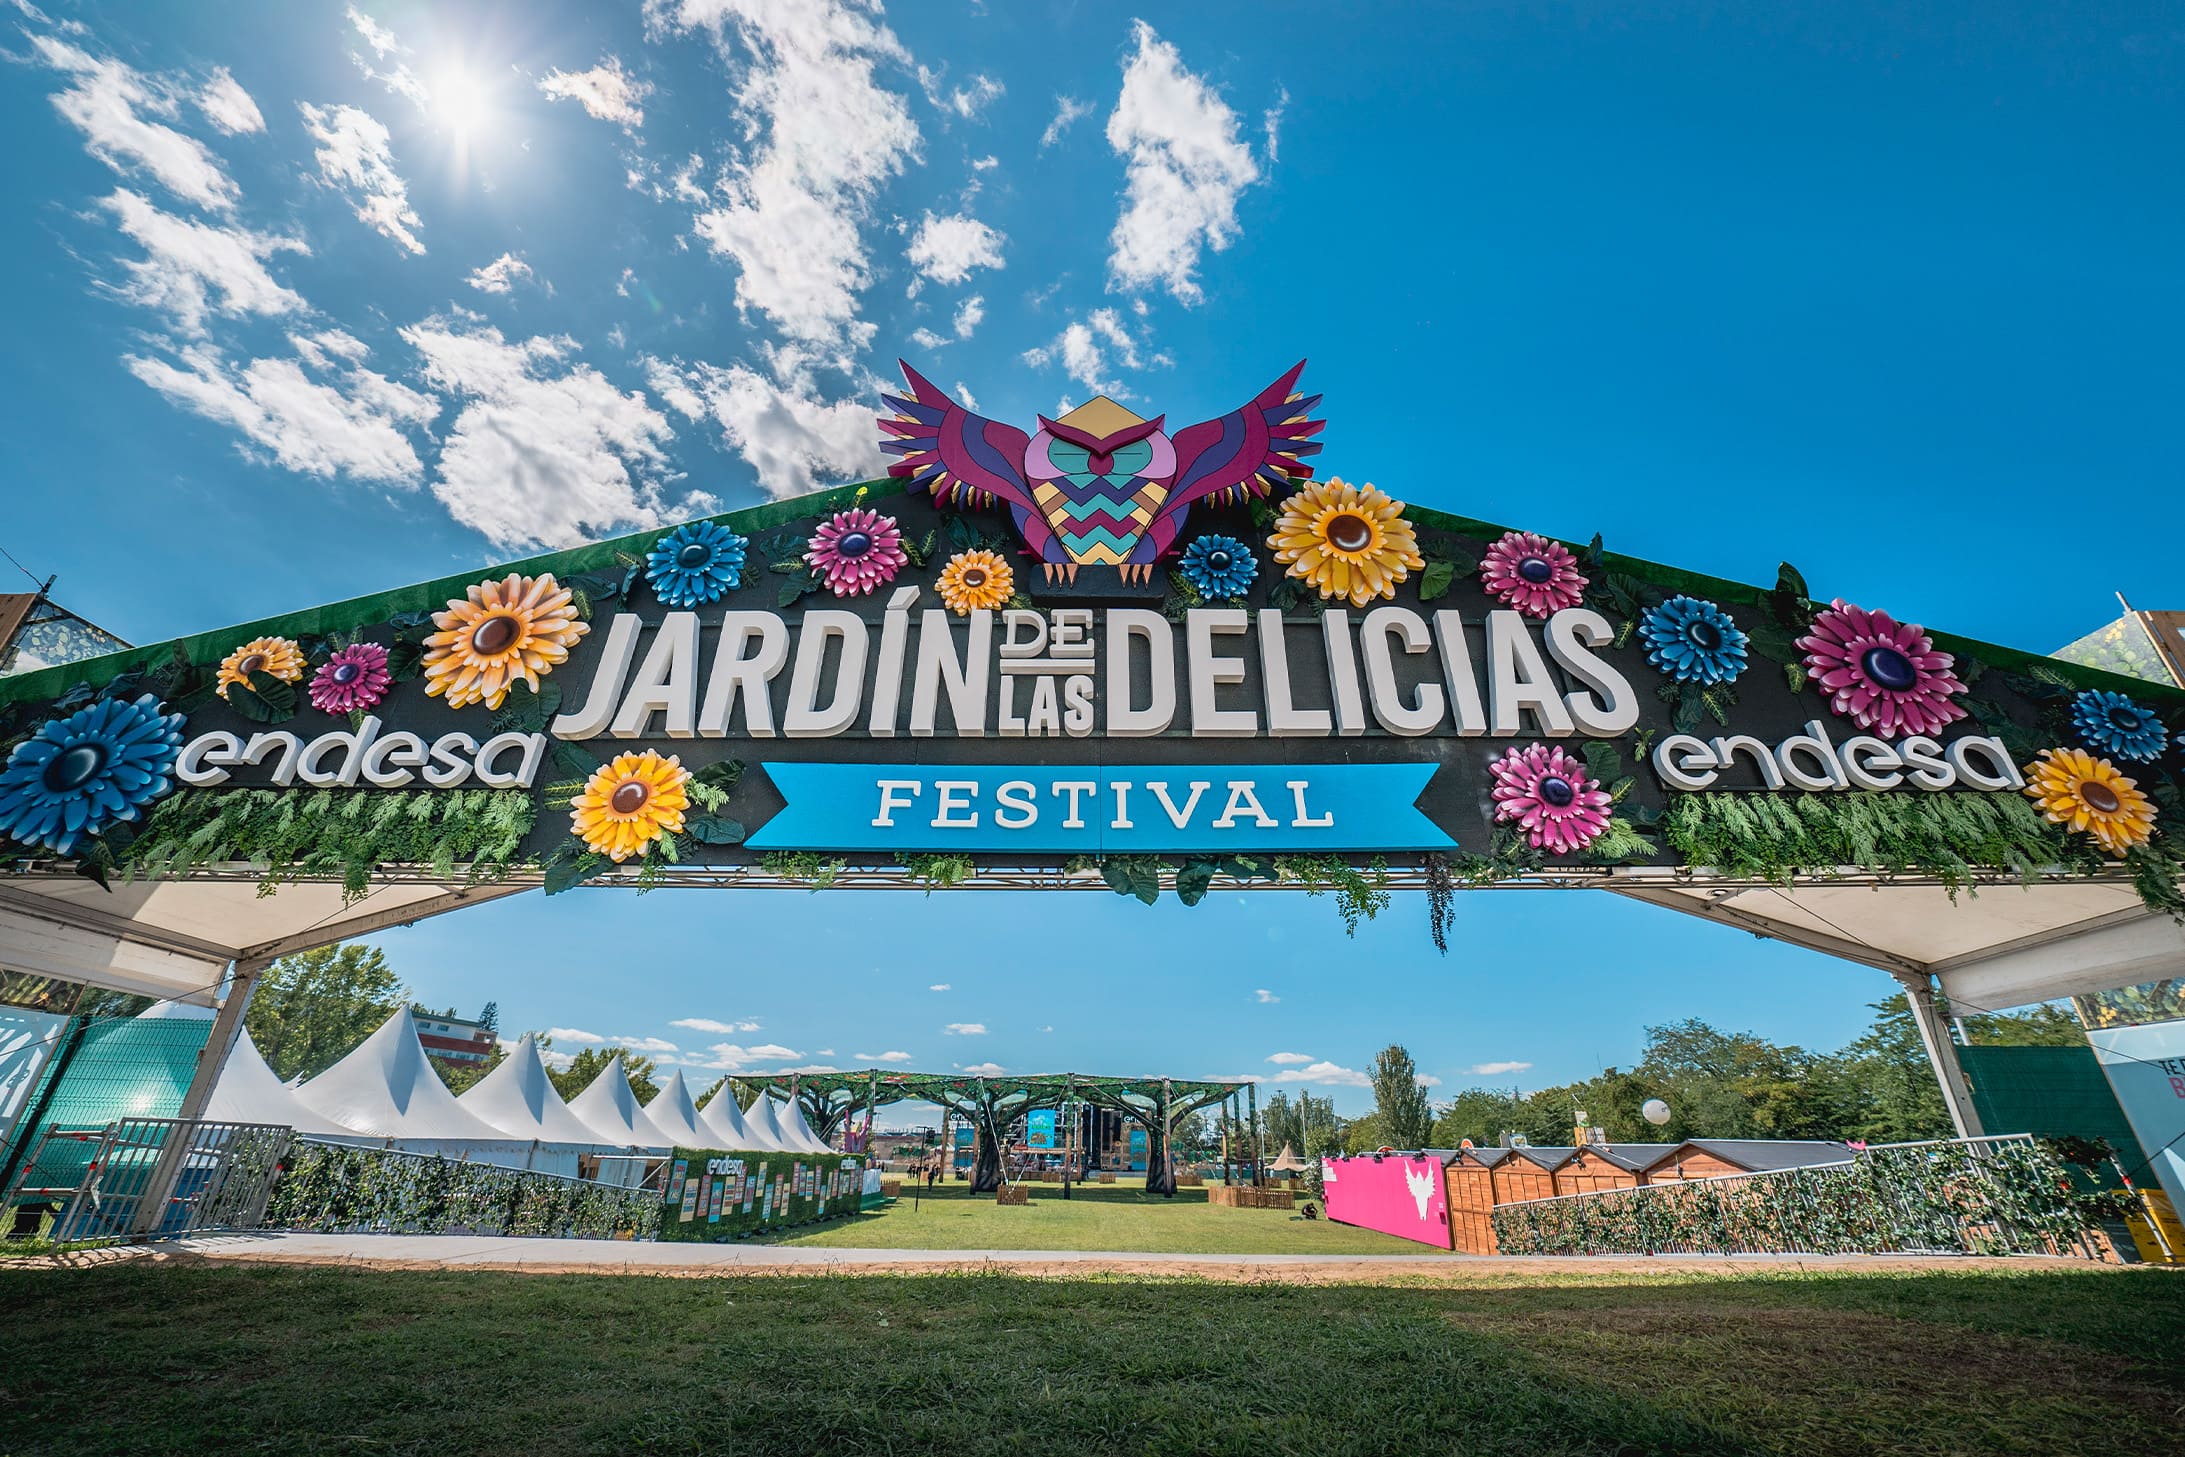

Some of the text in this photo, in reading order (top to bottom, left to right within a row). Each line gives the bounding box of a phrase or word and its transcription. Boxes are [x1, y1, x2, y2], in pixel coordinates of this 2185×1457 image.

[550, 584, 1640, 740] JARDÍN DE LAS DELICIAS
[175, 715, 548, 789] endesa
[1652, 719, 2027, 792] endesa
[871, 779, 1335, 829] FESTIVAL
